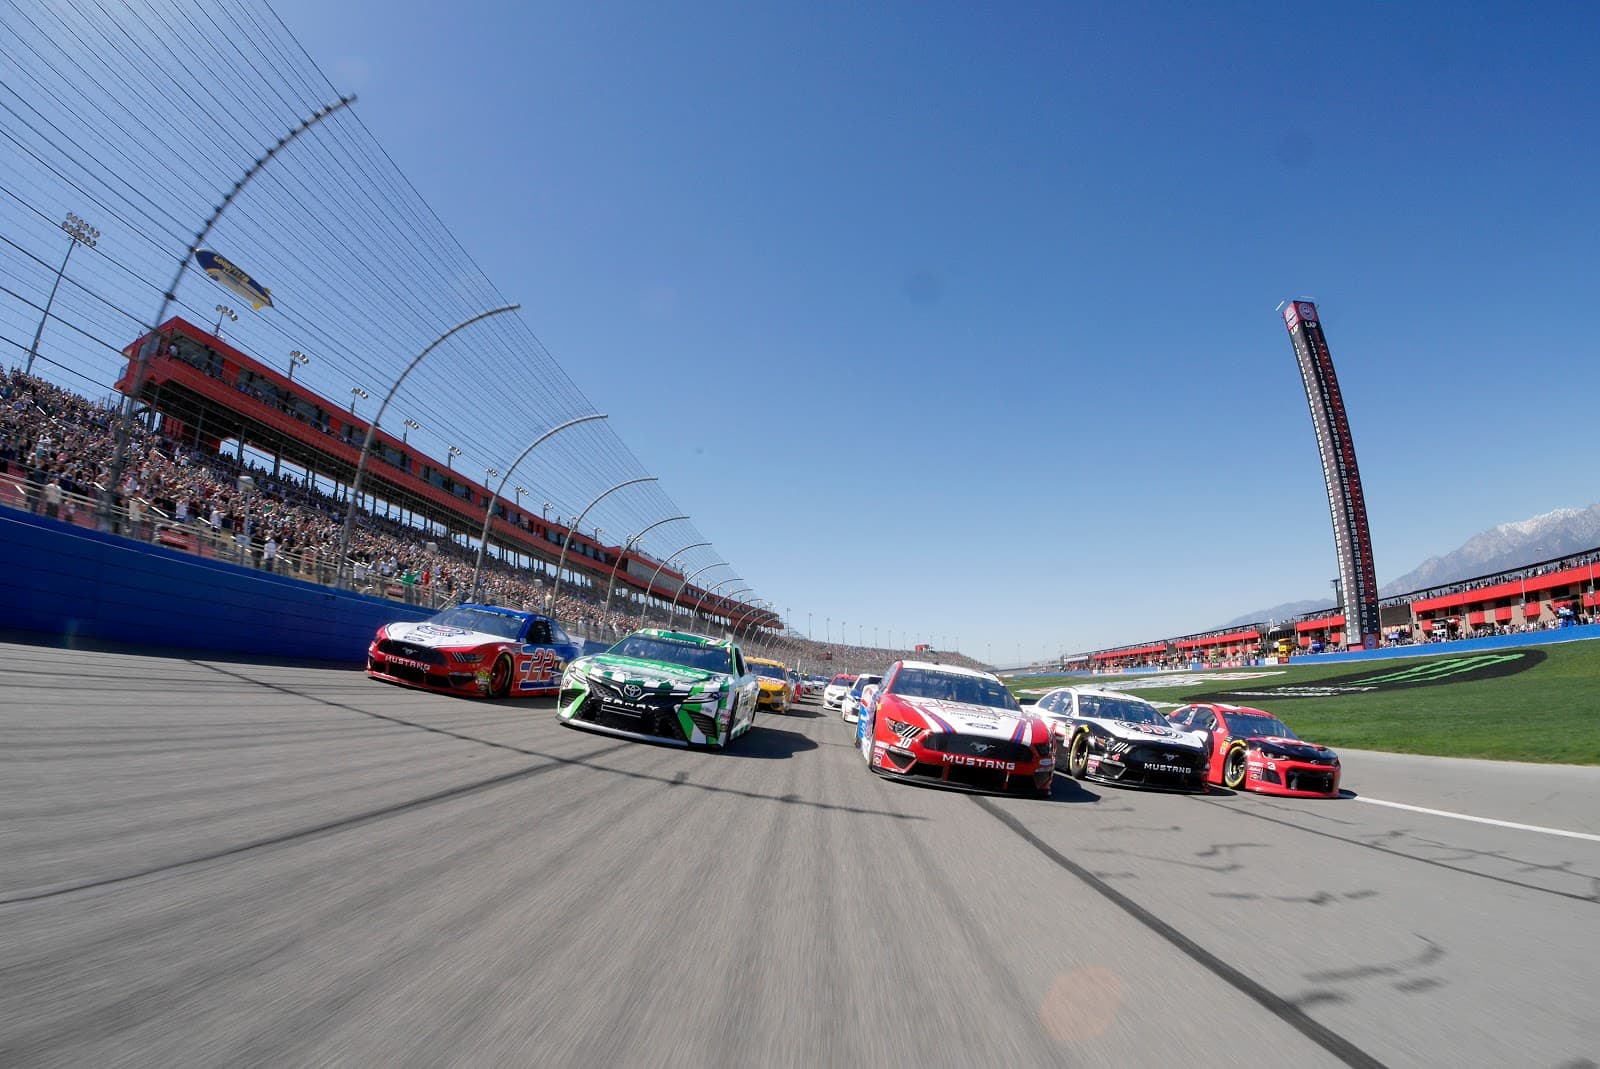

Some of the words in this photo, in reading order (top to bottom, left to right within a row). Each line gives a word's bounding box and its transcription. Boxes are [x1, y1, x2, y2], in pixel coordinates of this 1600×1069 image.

[1304, 321, 1317, 329] LAP
[384, 654, 431, 672] MUSTANG
[527, 648, 557, 683] 22
[897, 737, 913, 749] 10
[942, 753, 1016, 771] MUSTANG
[1143, 762, 1192, 775] MUSTANG
[1266, 762, 1277, 771] 3
